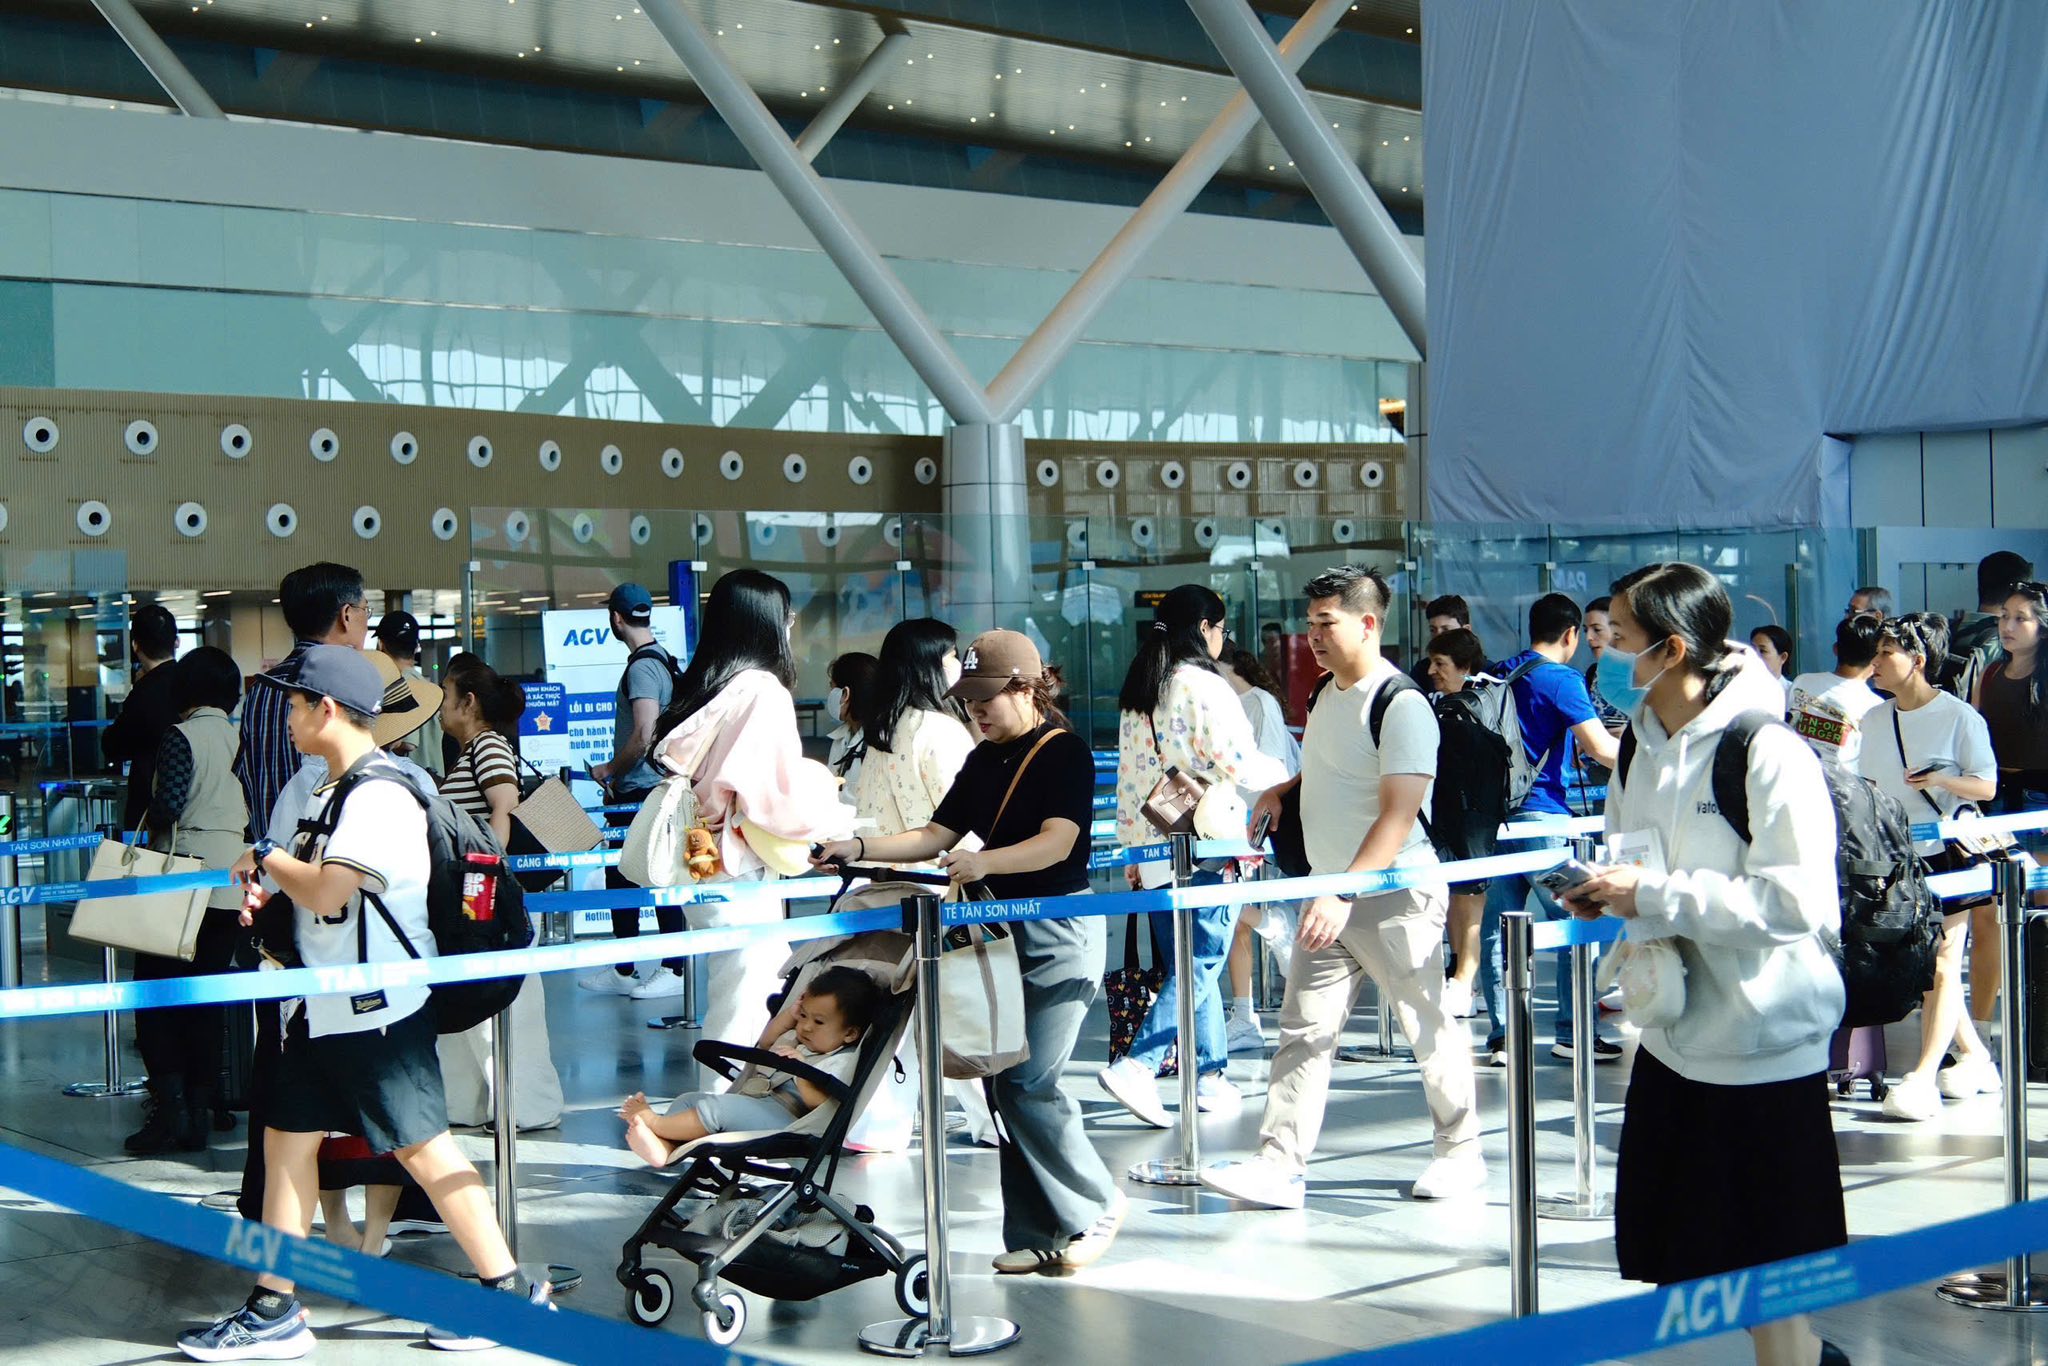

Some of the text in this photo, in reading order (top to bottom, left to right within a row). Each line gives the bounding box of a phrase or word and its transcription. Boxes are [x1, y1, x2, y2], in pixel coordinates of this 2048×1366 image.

[563, 628, 610, 646] ACV
[964, 647, 978, 670] LA
[596, 702, 612, 712] CHO
[569, 727, 584, 737] cho
[1798, 723, 1841, 743] URGER
[570, 740, 590, 750] huôn
[9, 843, 27, 852] TAN
[30, 841, 50, 850] SON
[52, 837, 76, 847] NHAT
[1143, 848, 1159, 858] TAN
[649, 888, 698, 906] TIA
[585, 912, 610, 921] Hotlin
[945, 900, 1041, 919] TẾ TÂN SƠN NHẤT
[224, 1218, 283, 1271] ACV
[1654, 1271, 1750, 1342] ACV
